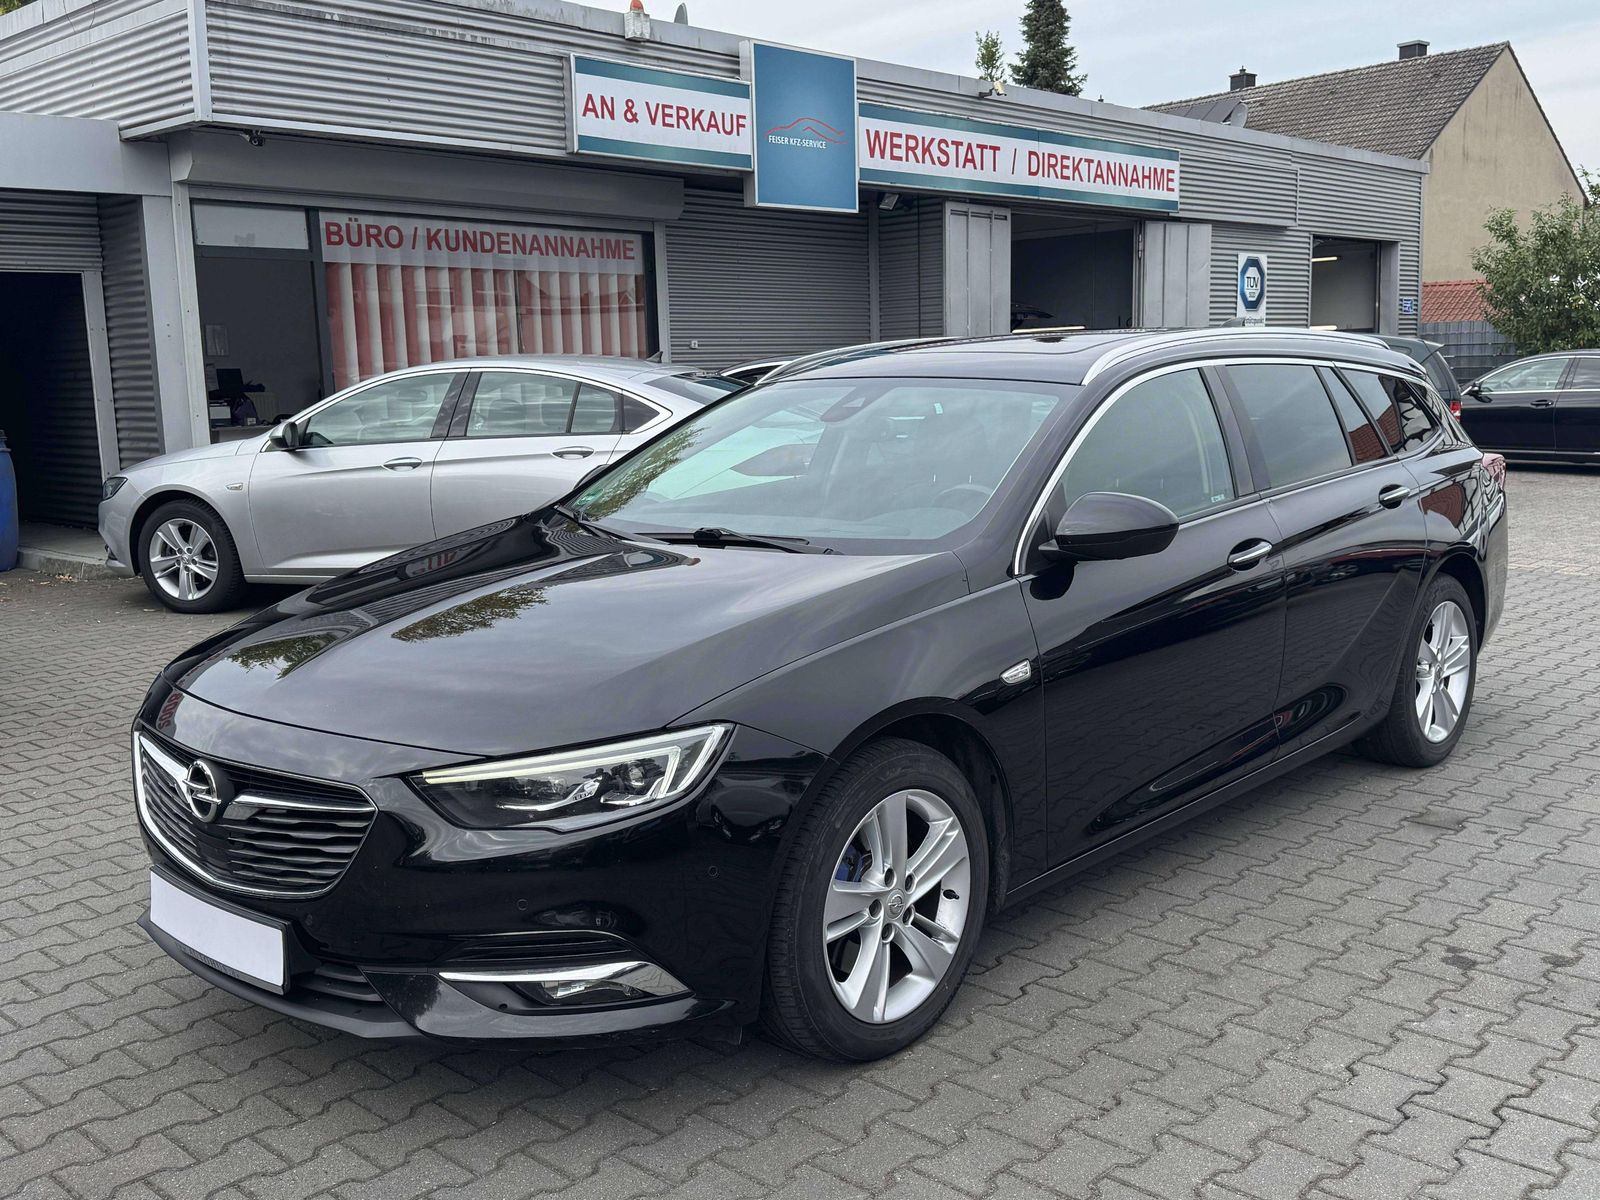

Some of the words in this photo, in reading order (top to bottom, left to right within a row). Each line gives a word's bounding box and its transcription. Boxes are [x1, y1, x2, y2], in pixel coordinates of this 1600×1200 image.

[582, 94, 616, 120] AN
[623, 99, 639, 123] &
[646, 102, 747, 137] VERKAUF
[768, 135, 789, 145] FEISER
[789, 138, 826, 149] KFZ-SERVICE
[866, 129, 1000, 172] WERKSTATT
[1011, 148, 1018, 176] /
[1027, 149, 1176, 192] DIREKTANNAHME
[325, 216, 404, 249] BÜRO
[411, 226, 419, 250] /
[426, 226, 636, 260] KUNDENANNAHME
